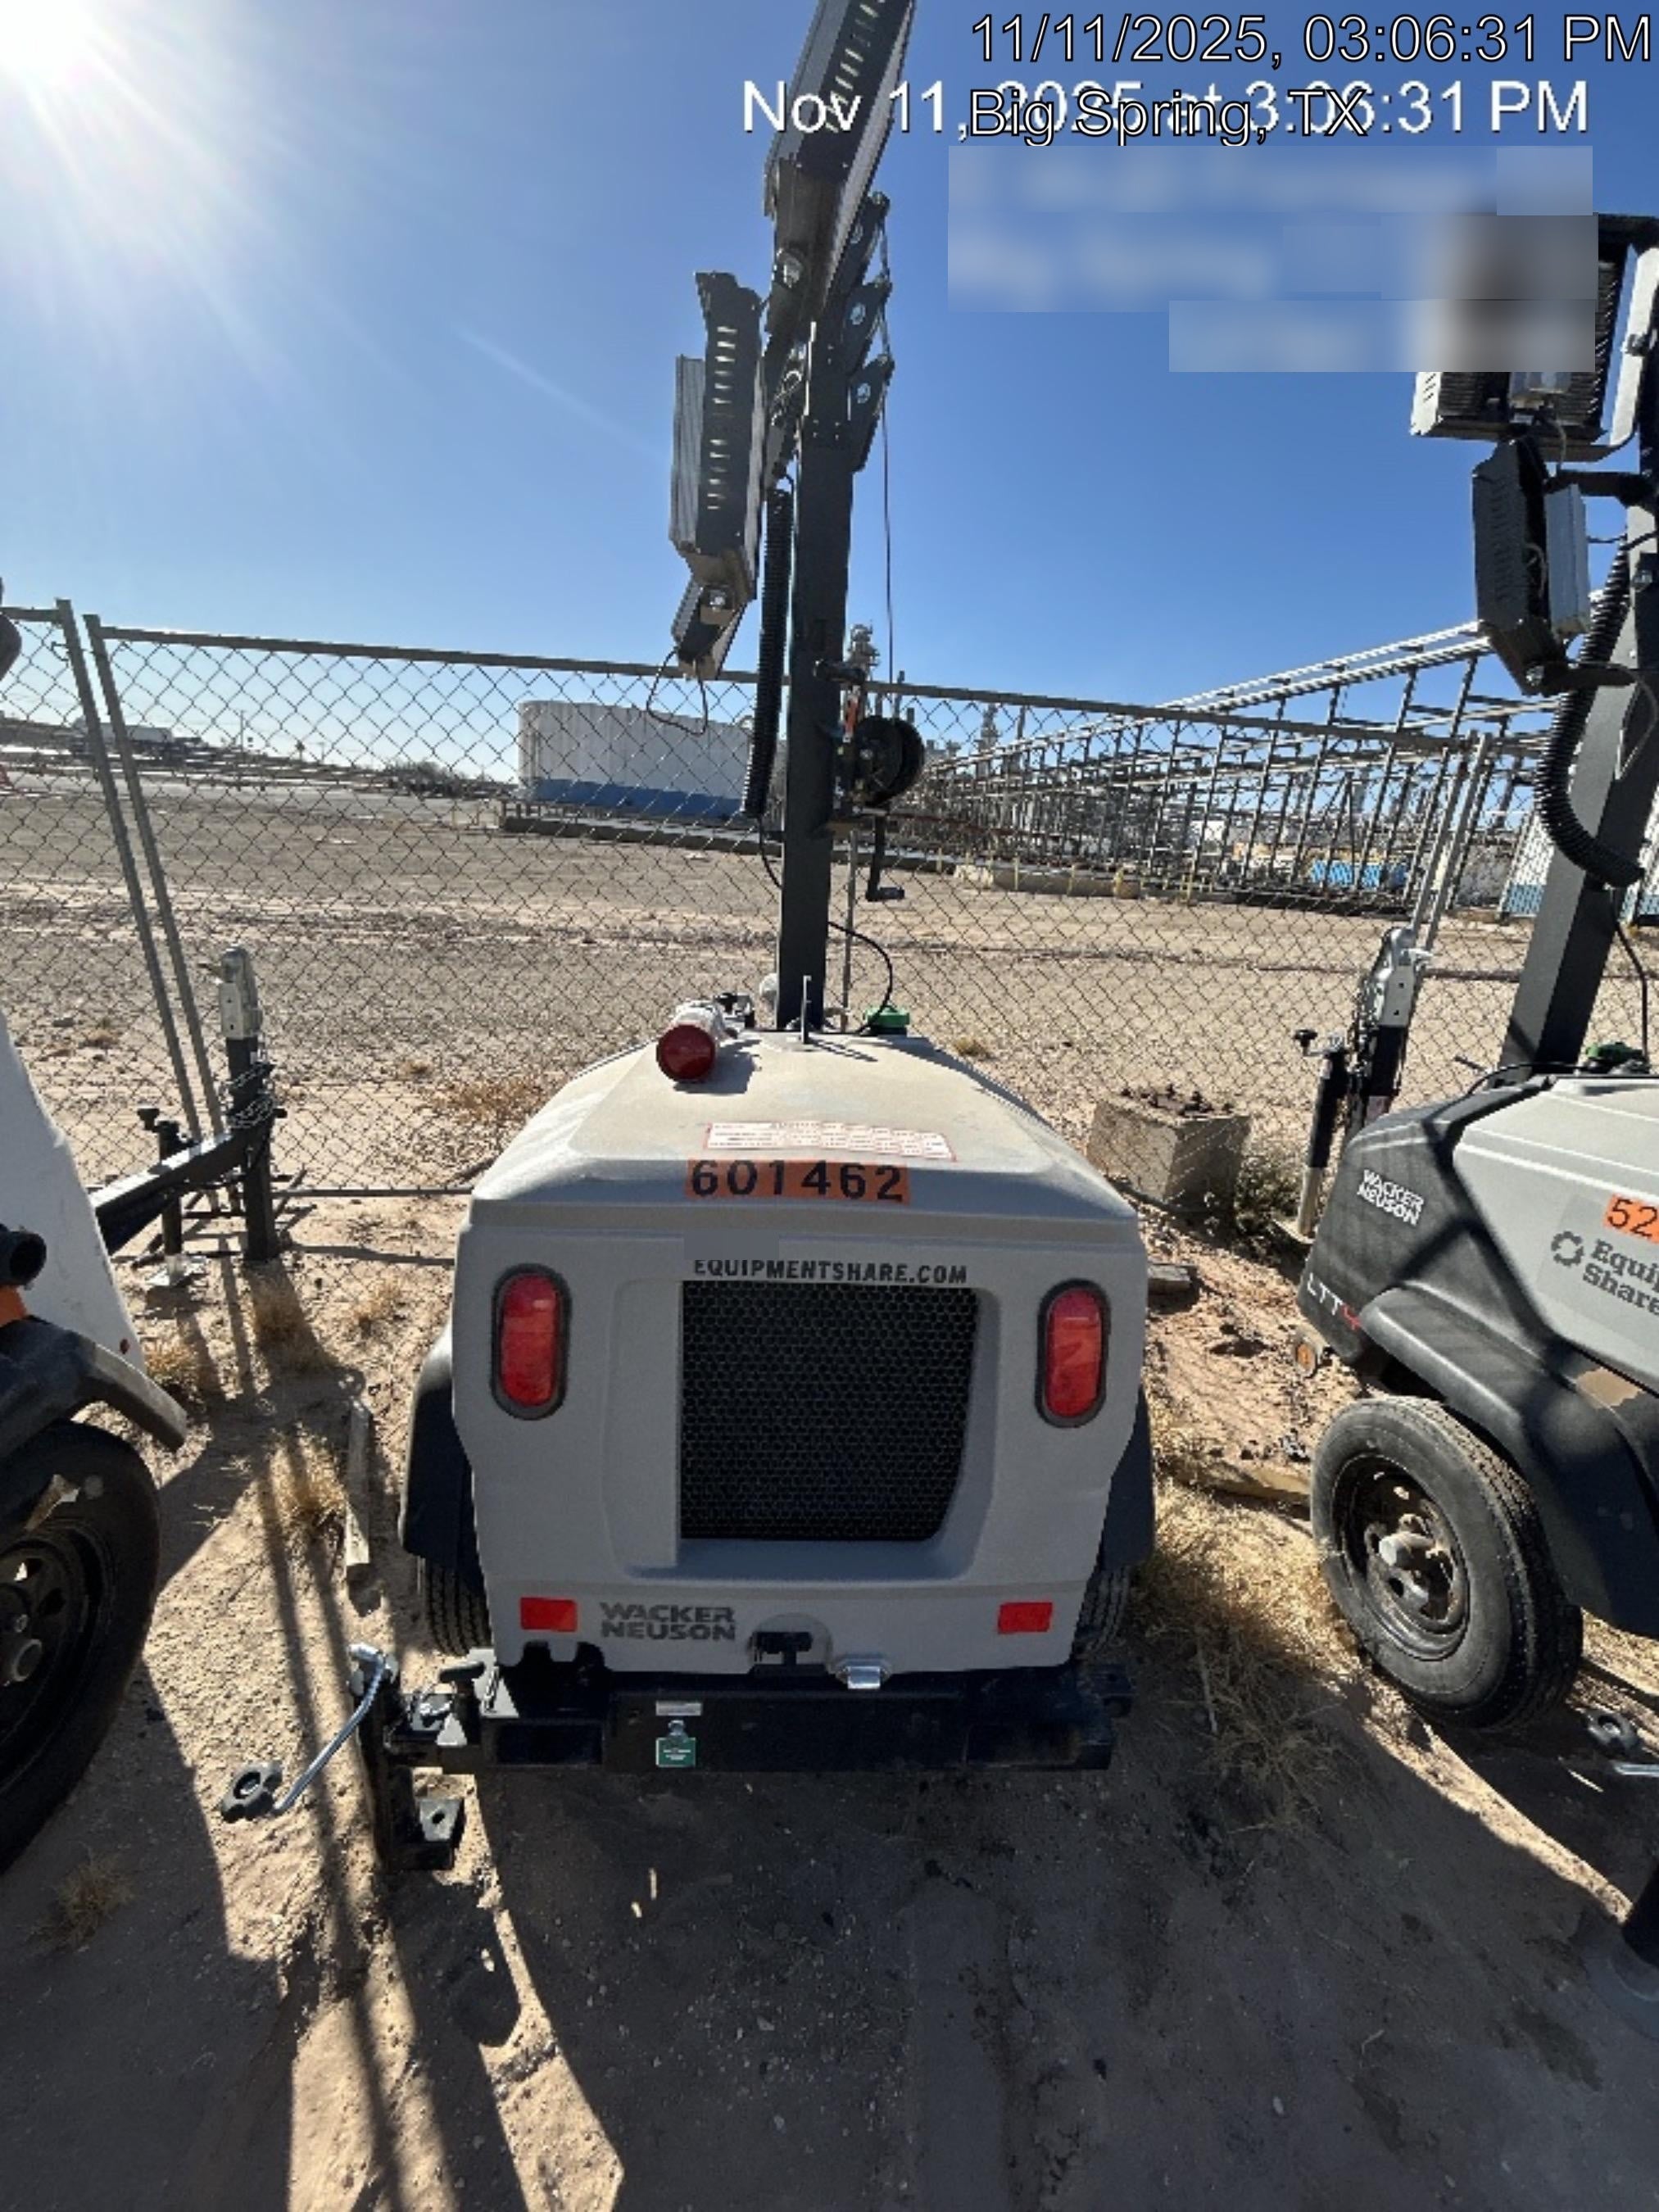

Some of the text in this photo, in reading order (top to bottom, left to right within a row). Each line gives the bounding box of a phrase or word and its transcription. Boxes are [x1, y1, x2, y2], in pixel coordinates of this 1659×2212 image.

[691, 1160, 904, 1201] 601462
[1363, 1169, 1424, 1213] WACKER
[1357, 1181, 1420, 1226] NEUSON
[694, 1259, 967, 1284] EQUIPMENTSHARE.COM
[1582, 1262, 1659, 1317] Share
[599, 1602, 735, 1622] WACKER
[601, 1620, 735, 1641] NEUSON
